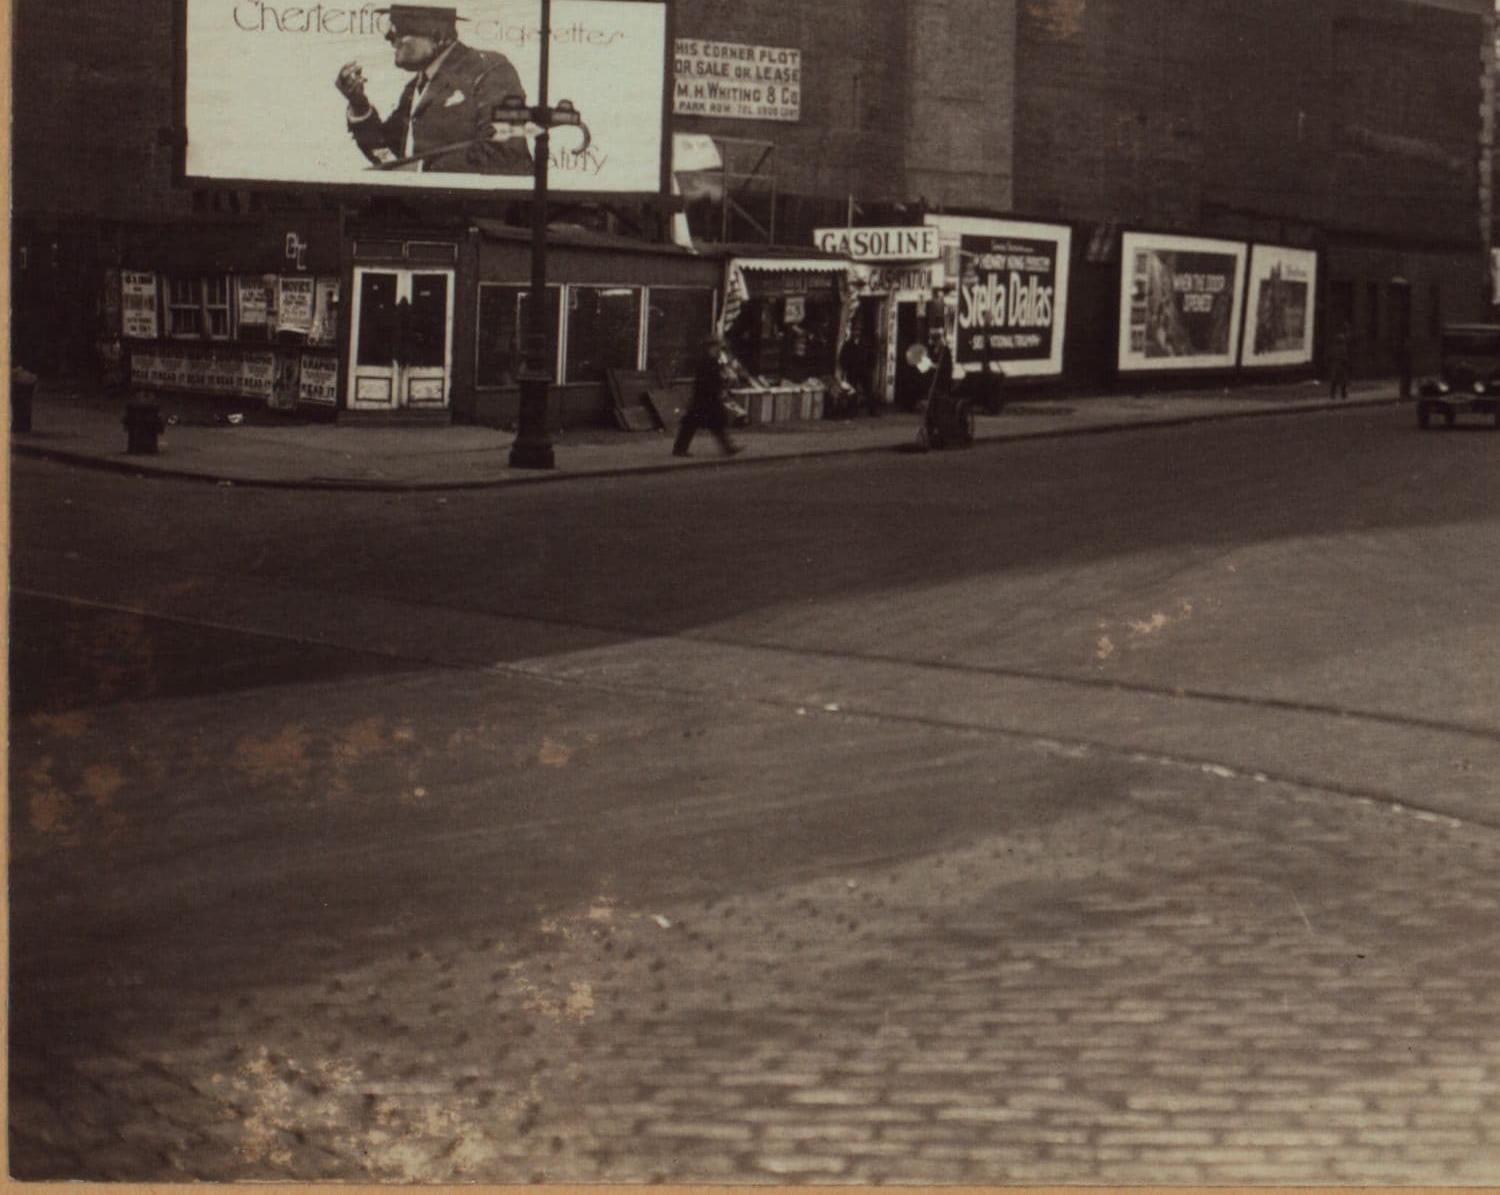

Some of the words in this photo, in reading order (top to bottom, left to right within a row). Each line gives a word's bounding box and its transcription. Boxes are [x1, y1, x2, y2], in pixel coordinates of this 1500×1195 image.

[703, 44, 755, 61] CORNER
[759, 49, 799, 64] PLOT
[696, 61, 731, 78] SALE
[757, 66, 800, 83] LEASE
[821, 231, 934, 256] GASOLINE
[958, 272, 1006, 329] Stella
[1008, 272, 1054, 328] Dallas
